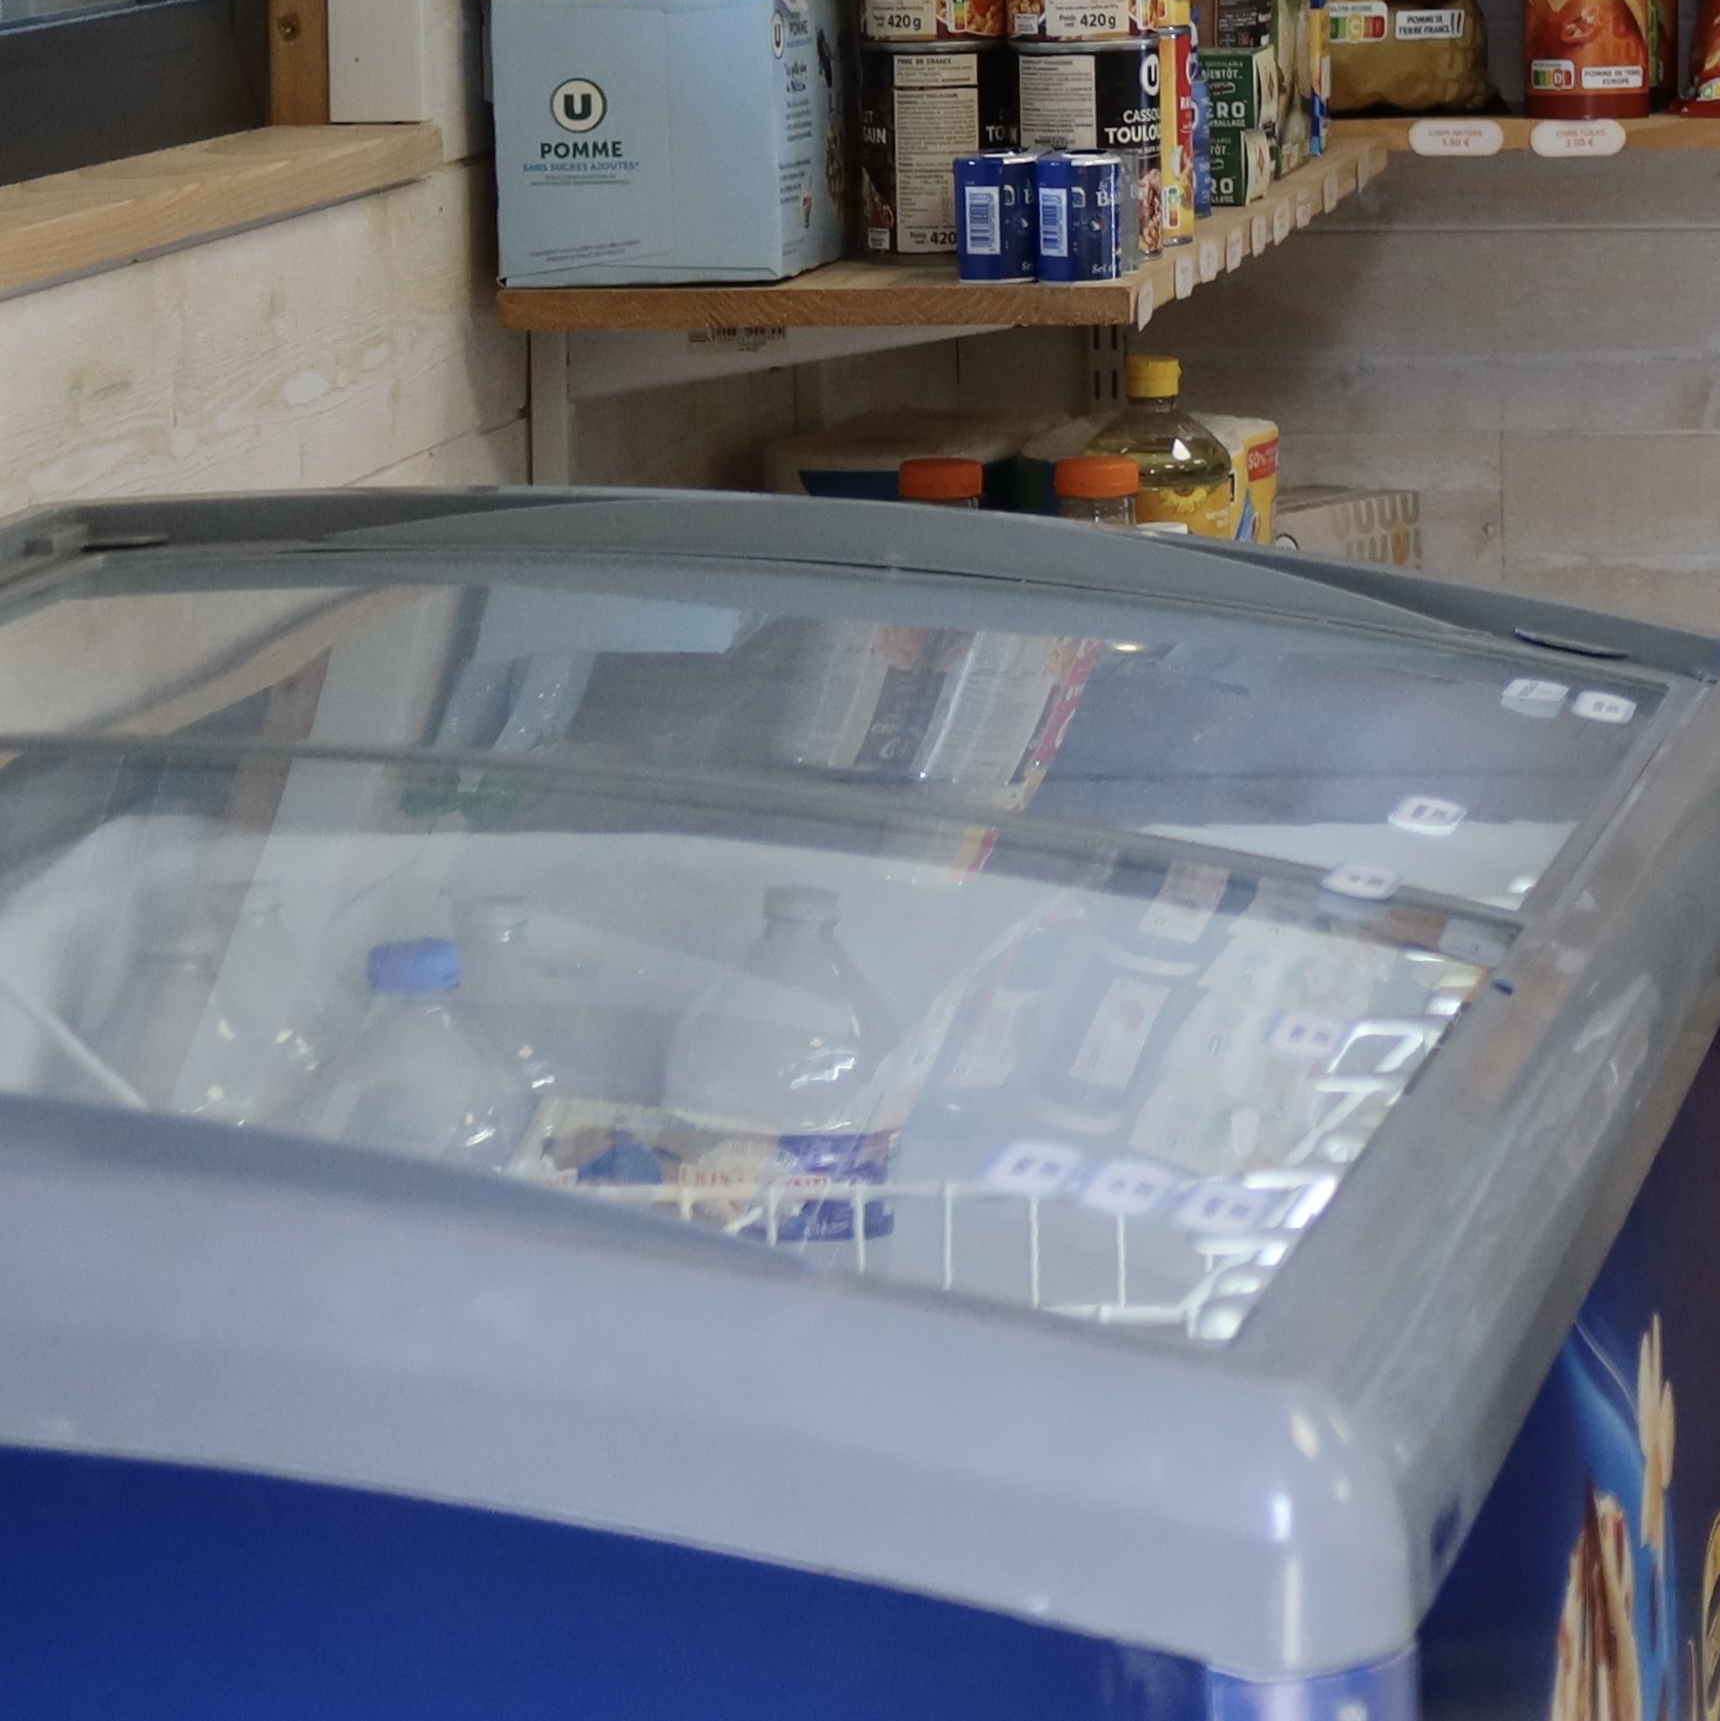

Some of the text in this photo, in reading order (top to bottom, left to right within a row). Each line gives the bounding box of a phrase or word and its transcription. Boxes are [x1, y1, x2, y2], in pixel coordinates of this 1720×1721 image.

[887, 15, 910, 27] 420
[1080, 14, 1107, 27] 420
[1584, 69, 1613, 78] POMME
[563, 93, 592, 122] U
[540, 140, 624, 160] POMME
[523, 163, 548, 173] SANS
